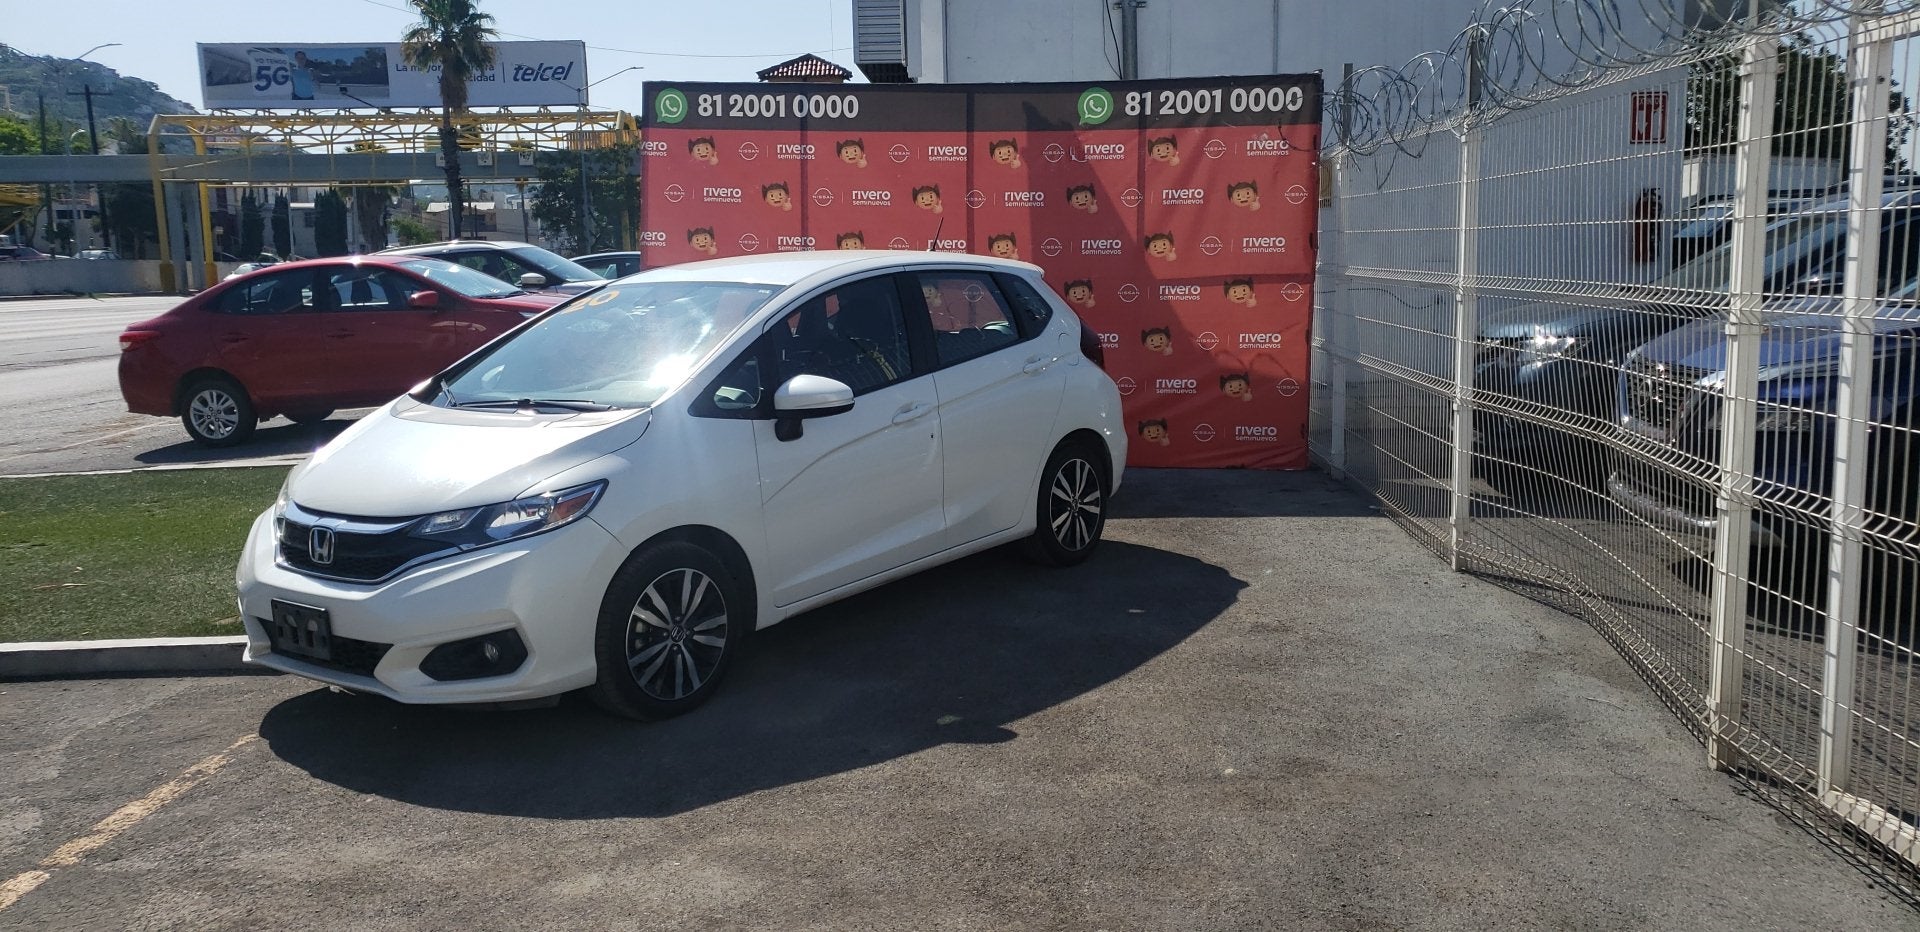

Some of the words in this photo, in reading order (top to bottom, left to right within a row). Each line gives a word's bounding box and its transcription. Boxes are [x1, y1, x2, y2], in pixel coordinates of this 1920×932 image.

[395, 63, 408, 72] La
[410, 64, 442, 73] myor
[513, 61, 574, 82] telcel
[254, 65, 290, 91] 5G
[698, 94, 723, 117] 81
[729, 94, 786, 118] 2001
[793, 94, 859, 119] 0000
[1124, 91, 1152, 116] 81
[1159, 88, 1223, 115] 2001
[1229, 86, 1304, 113] 0000
[641, 141, 668, 151] vero
[777, 143, 815, 154] rivero
[1084, 143, 1125, 154] rivero
[1246, 138, 1289, 150] rivero
[928, 145, 967, 156] rivero
[703, 187, 742, 197] rivero
[852, 190, 891, 200] rivero
[1004, 191, 1044, 201] rivero
[1162, 188, 1204, 199] rivero
[640, 231, 667, 241] vero
[777, 235, 816, 246] rivero
[927, 239, 967, 249] rvero
[1081, 239, 1122, 249] rivero
[1242, 237, 1286, 247] rivero
[1159, 285, 1200, 295] rivero
[1098, 333, 1119, 343] ero
[1239, 332, 1282, 343] rivero
[1156, 378, 1197, 389] rivero
[1235, 425, 1277, 436] rivero
